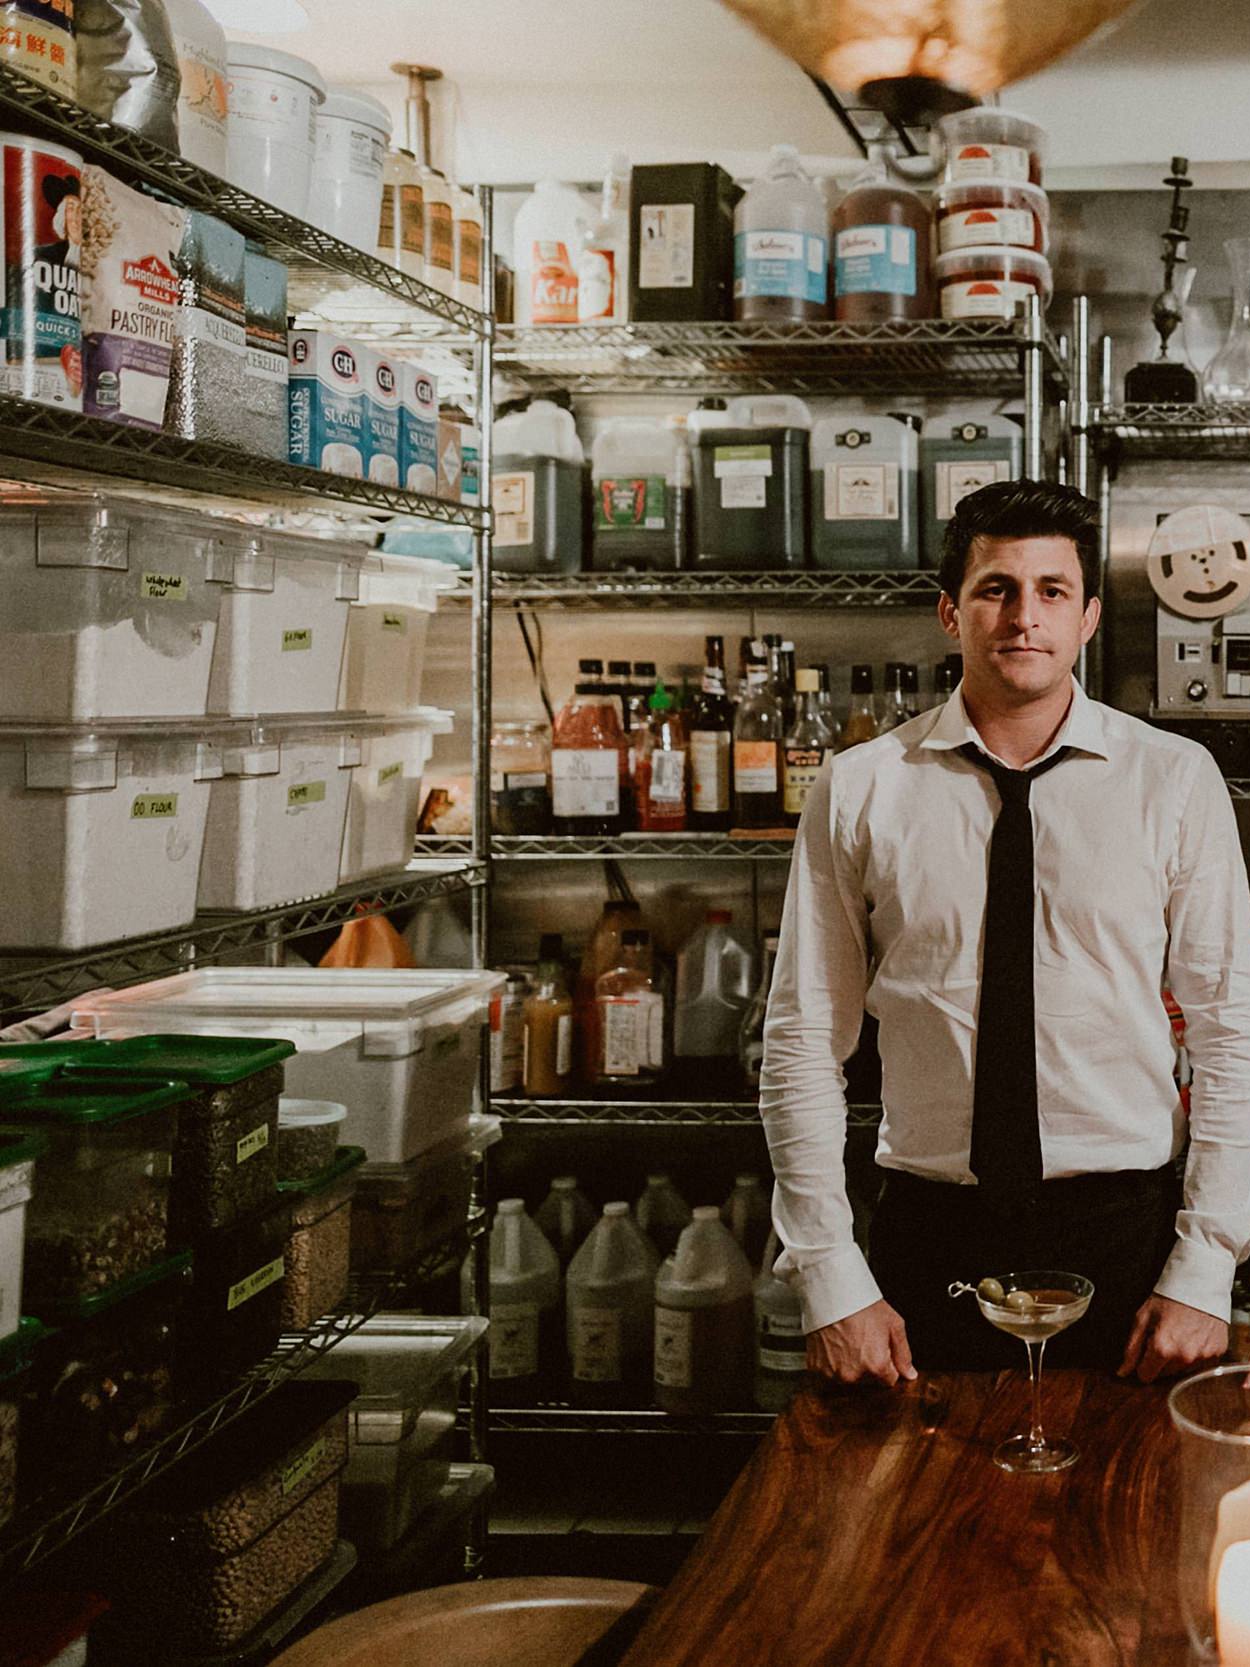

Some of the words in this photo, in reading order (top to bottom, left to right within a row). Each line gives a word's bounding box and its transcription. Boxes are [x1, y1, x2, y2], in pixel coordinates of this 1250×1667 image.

[32, 260, 80, 296] QUA
[126, 265, 177, 291] ARROWHEA
[54, 289, 80, 318] OA
[144, 286, 170, 301] MILLS
[535, 280, 576, 304] Kar
[138, 302, 174, 320] ORGANIC
[36, 321, 69, 336] QUICK
[111, 309, 158, 338] PASTRY
[159, 320, 176, 343] FLO
[290, 391, 304, 456] SUGAR
[324, 406, 361, 430] SUGAR
